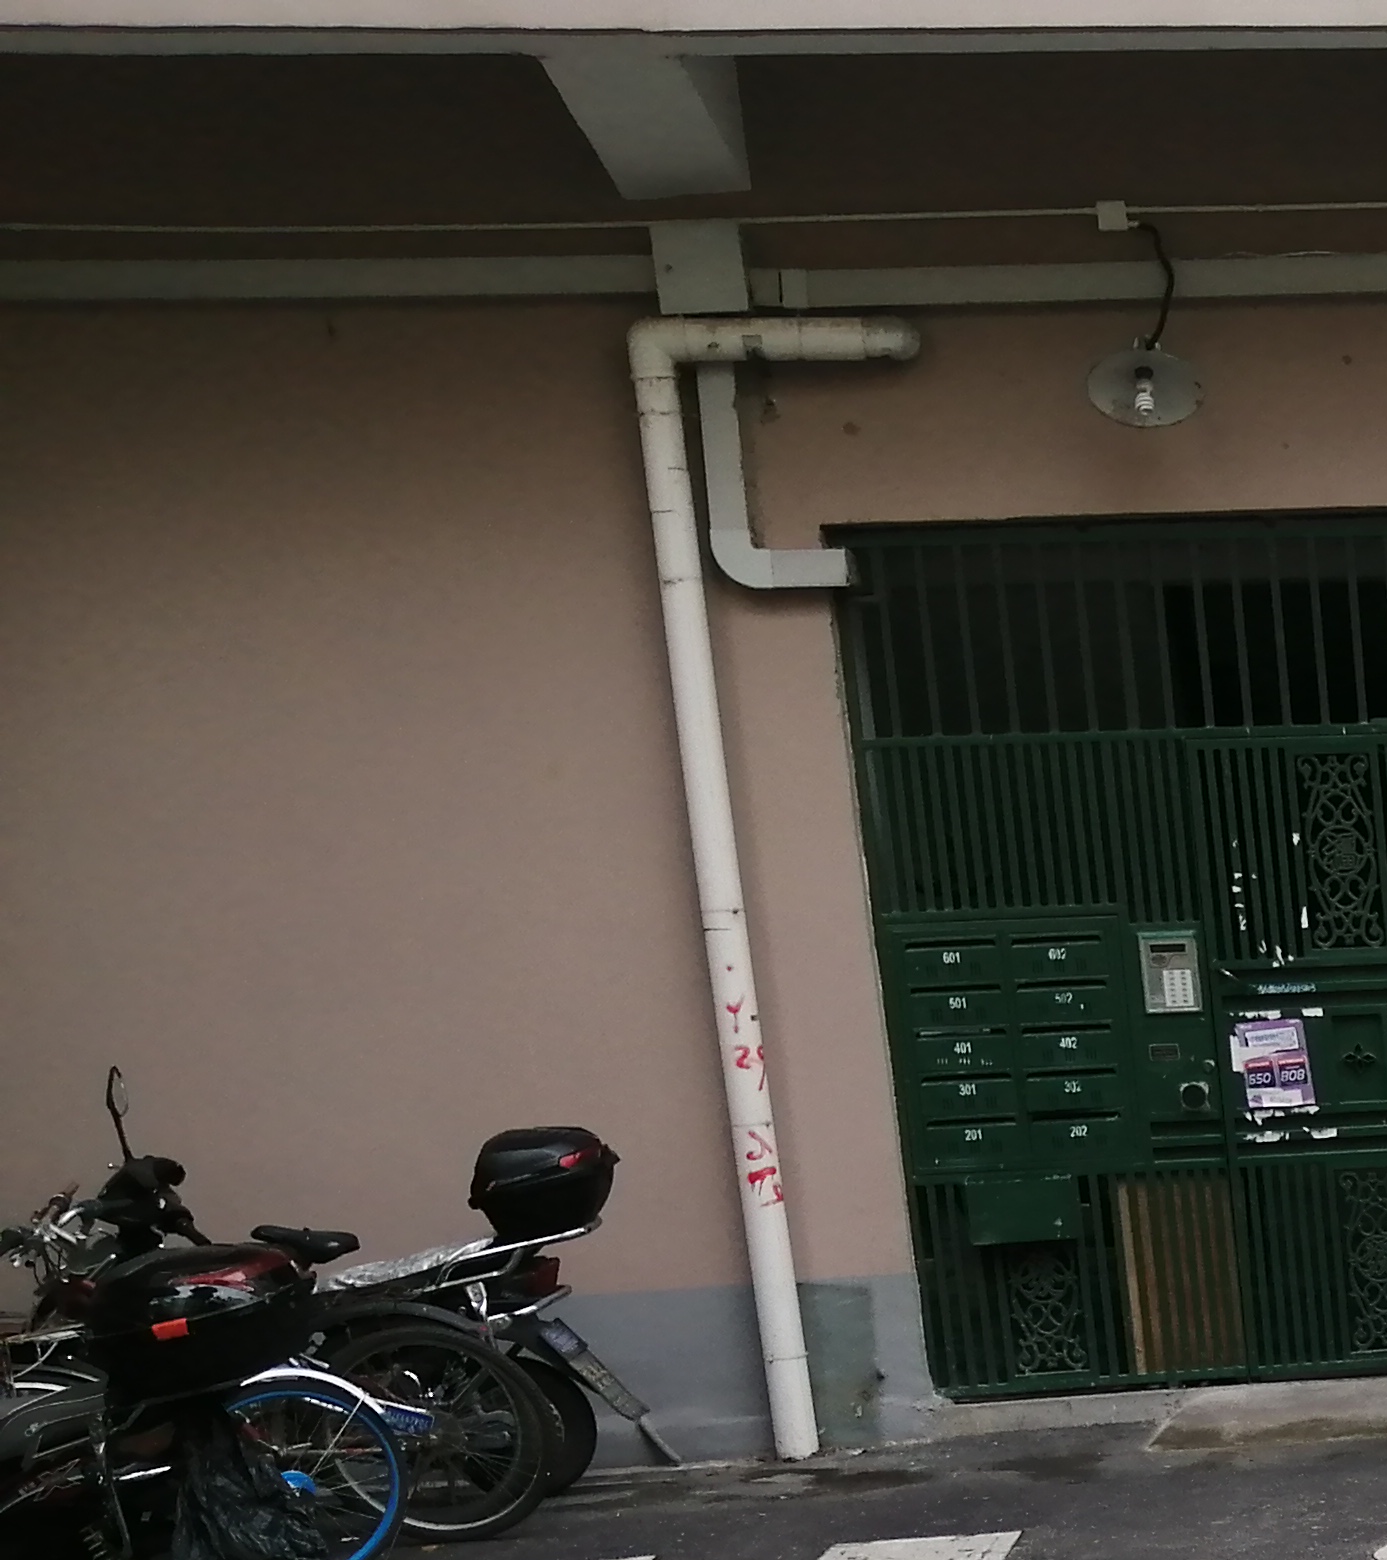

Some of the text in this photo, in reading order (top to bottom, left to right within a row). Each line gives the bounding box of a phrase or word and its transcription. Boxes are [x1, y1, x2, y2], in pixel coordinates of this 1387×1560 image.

[942, 952, 962, 964] 601
[949, 997, 967, 1009] 501
[953, 1042, 972, 1054] 401
[1059, 1037, 1078, 1050] 402
[958, 1083, 977, 1096] 301
[964, 1129, 983, 1141] 201
[1069, 1125, 1089, 1138] 202
